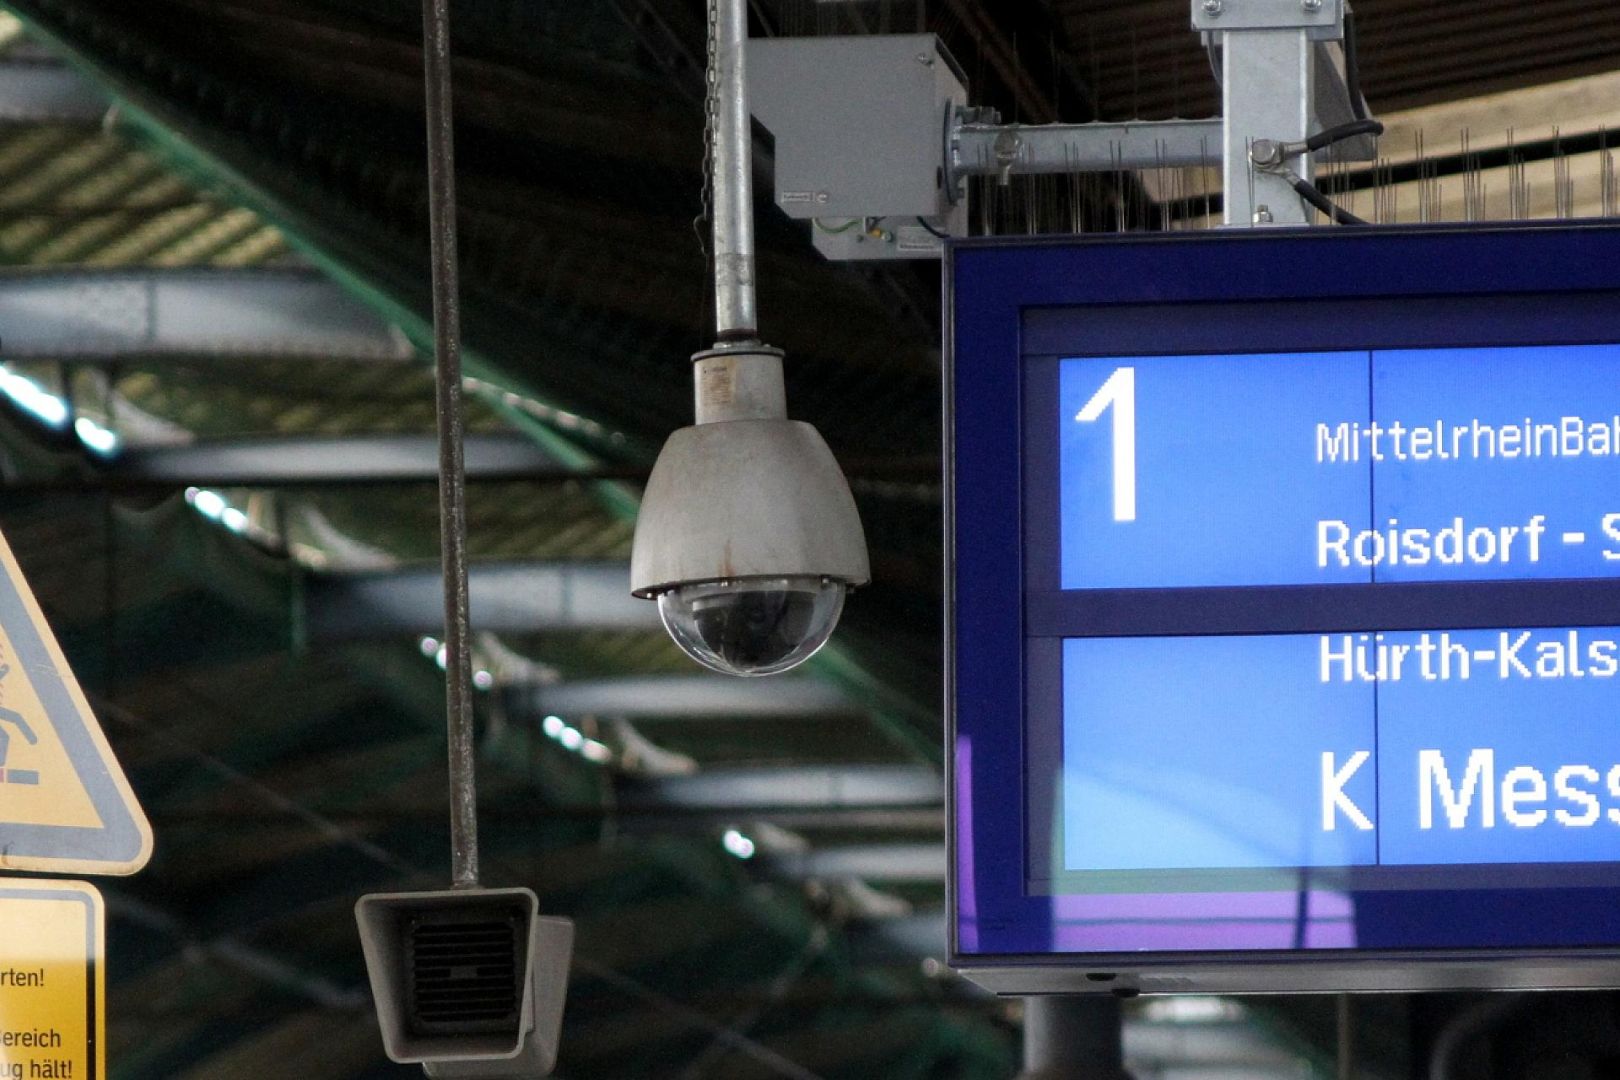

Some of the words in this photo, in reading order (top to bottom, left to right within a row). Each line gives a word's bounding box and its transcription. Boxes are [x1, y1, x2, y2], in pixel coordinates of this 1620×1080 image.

[1075, 367, 1136, 521] 1
[1317, 514, 1546, 568] Roisdorf
[1562, 531, 1585, 544] -
[1320, 630, 1619, 682] Hürth-Kals
[1321, 750, 1375, 831] K
[1418, 747, 1620, 830] Mes
[0, 1028, 62, 1048] ereich
[30, 1059, 72, 1079] hält!
